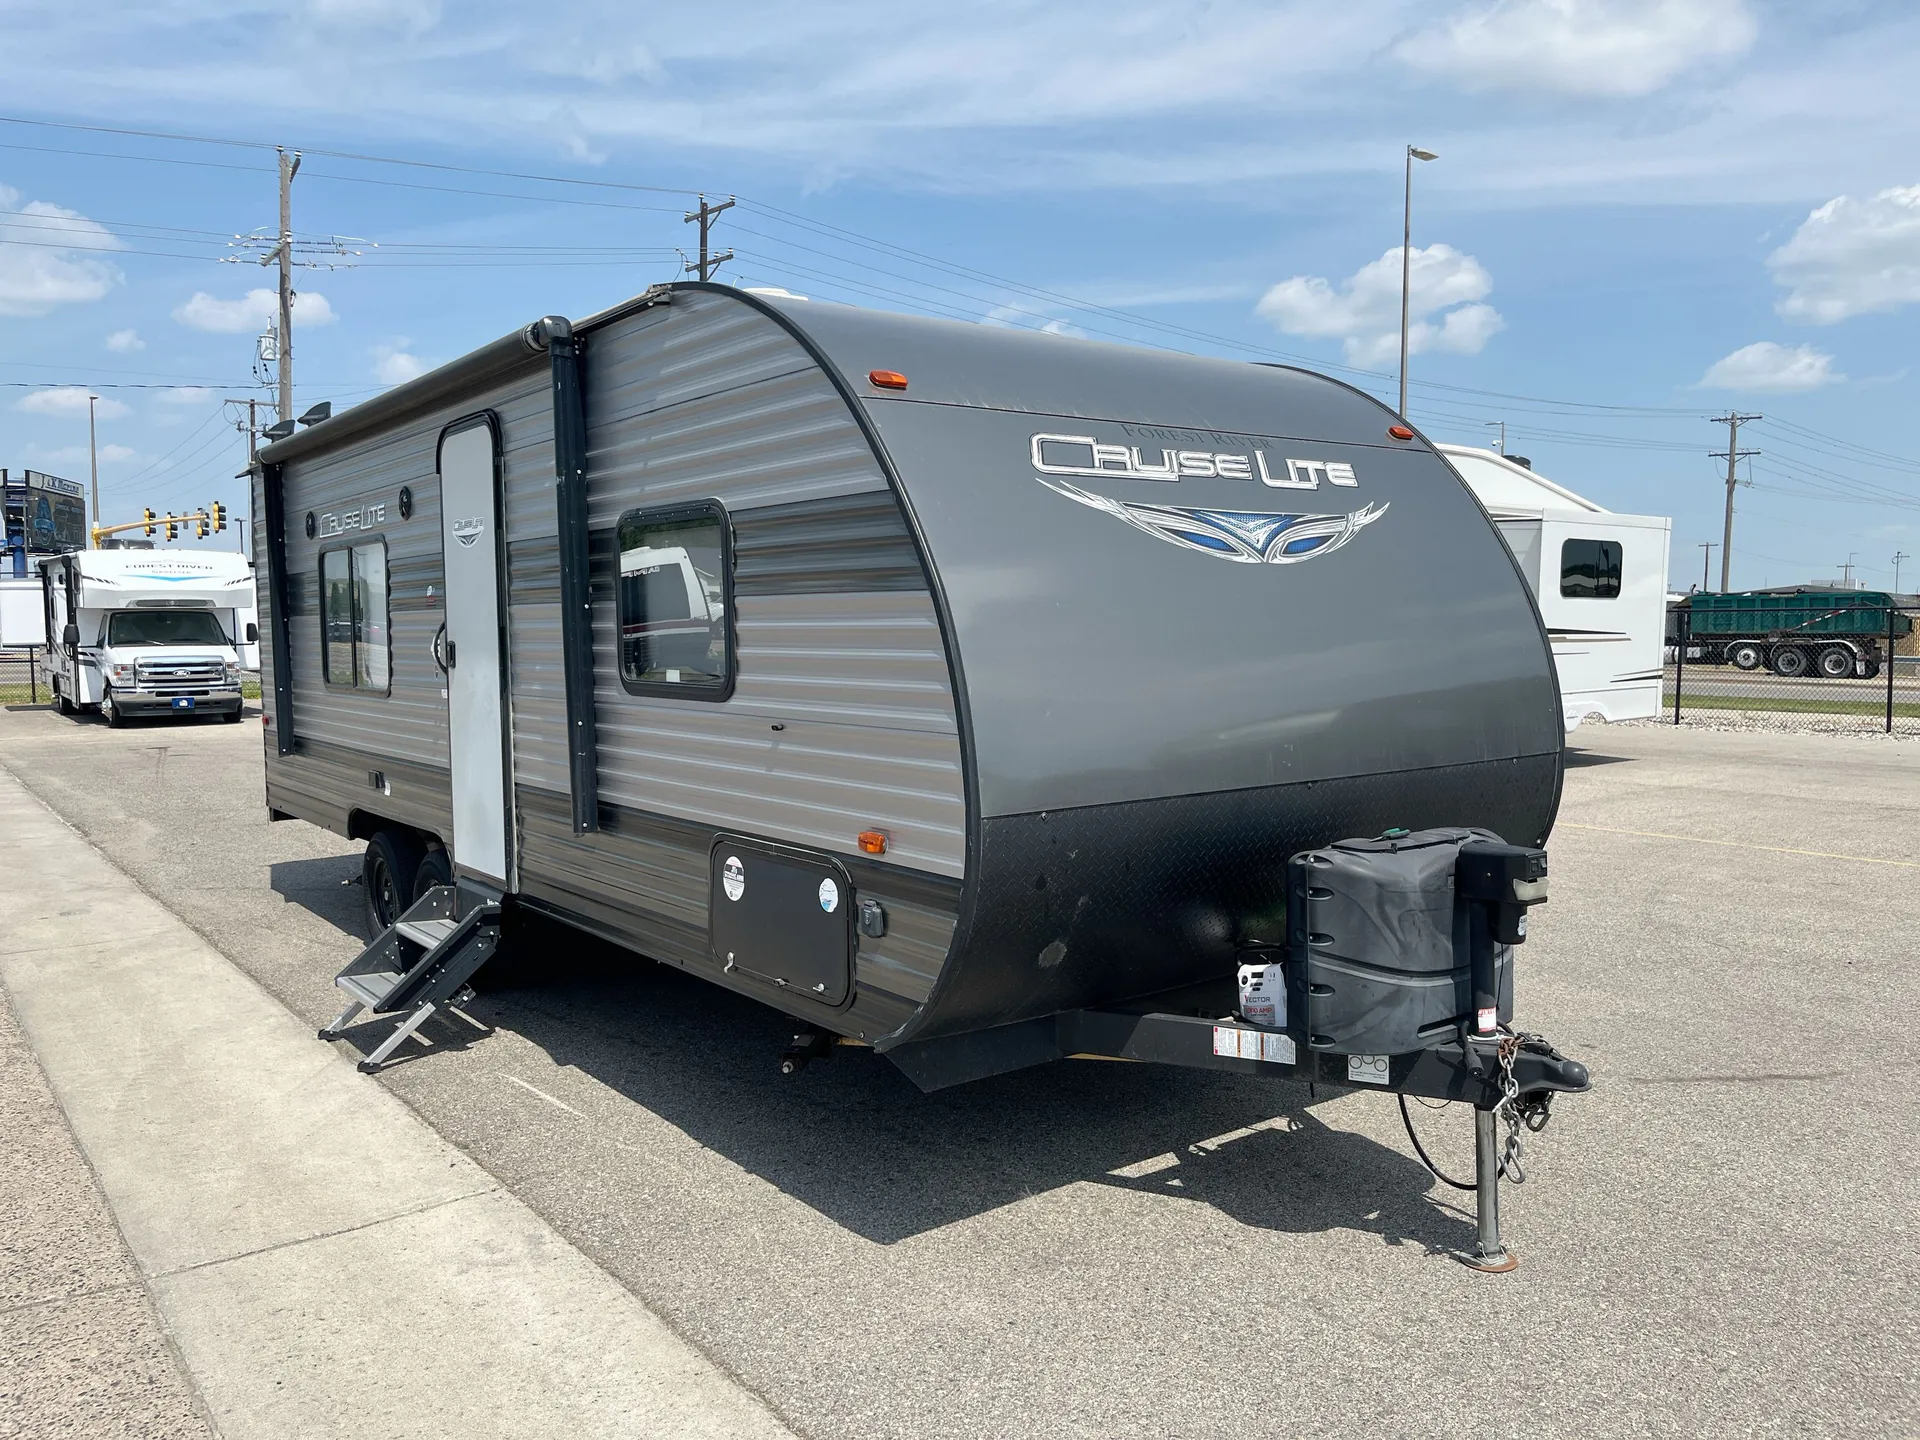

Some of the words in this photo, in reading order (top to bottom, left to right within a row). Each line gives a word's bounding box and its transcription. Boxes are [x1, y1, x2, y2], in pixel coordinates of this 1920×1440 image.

[1120, 423, 1207, 444] FOREST
[1208, 431, 1275, 450] RIVER
[1244, 994, 1271, 1004] VECTOR
[1259, 1006, 1273, 1014] AMP
